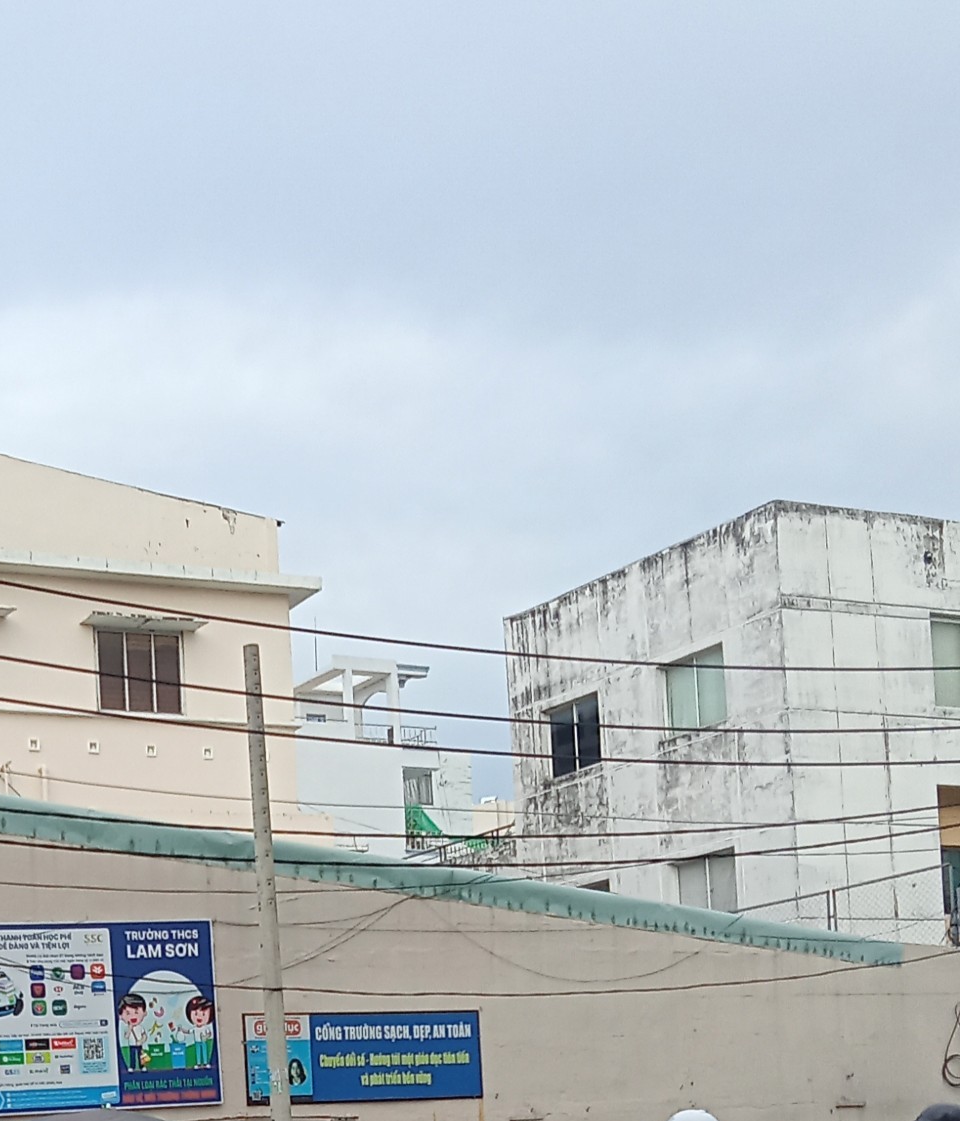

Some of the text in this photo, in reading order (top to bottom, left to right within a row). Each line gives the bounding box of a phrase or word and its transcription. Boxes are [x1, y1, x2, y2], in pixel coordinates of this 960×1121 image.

[43, 934, 59, 942] HỌC
[84, 934, 103, 944] SSC
[124, 927, 199, 941] TRƯỜNG THCS
[126, 942, 199, 959] LAM SƠN
[344, 1023, 382, 1040] TRƯỜNG
[383, 1025, 412, 1042] SẠCH,
[432, 1024, 445, 1039] AN
[447, 1021, 471, 1039] TOÀN
